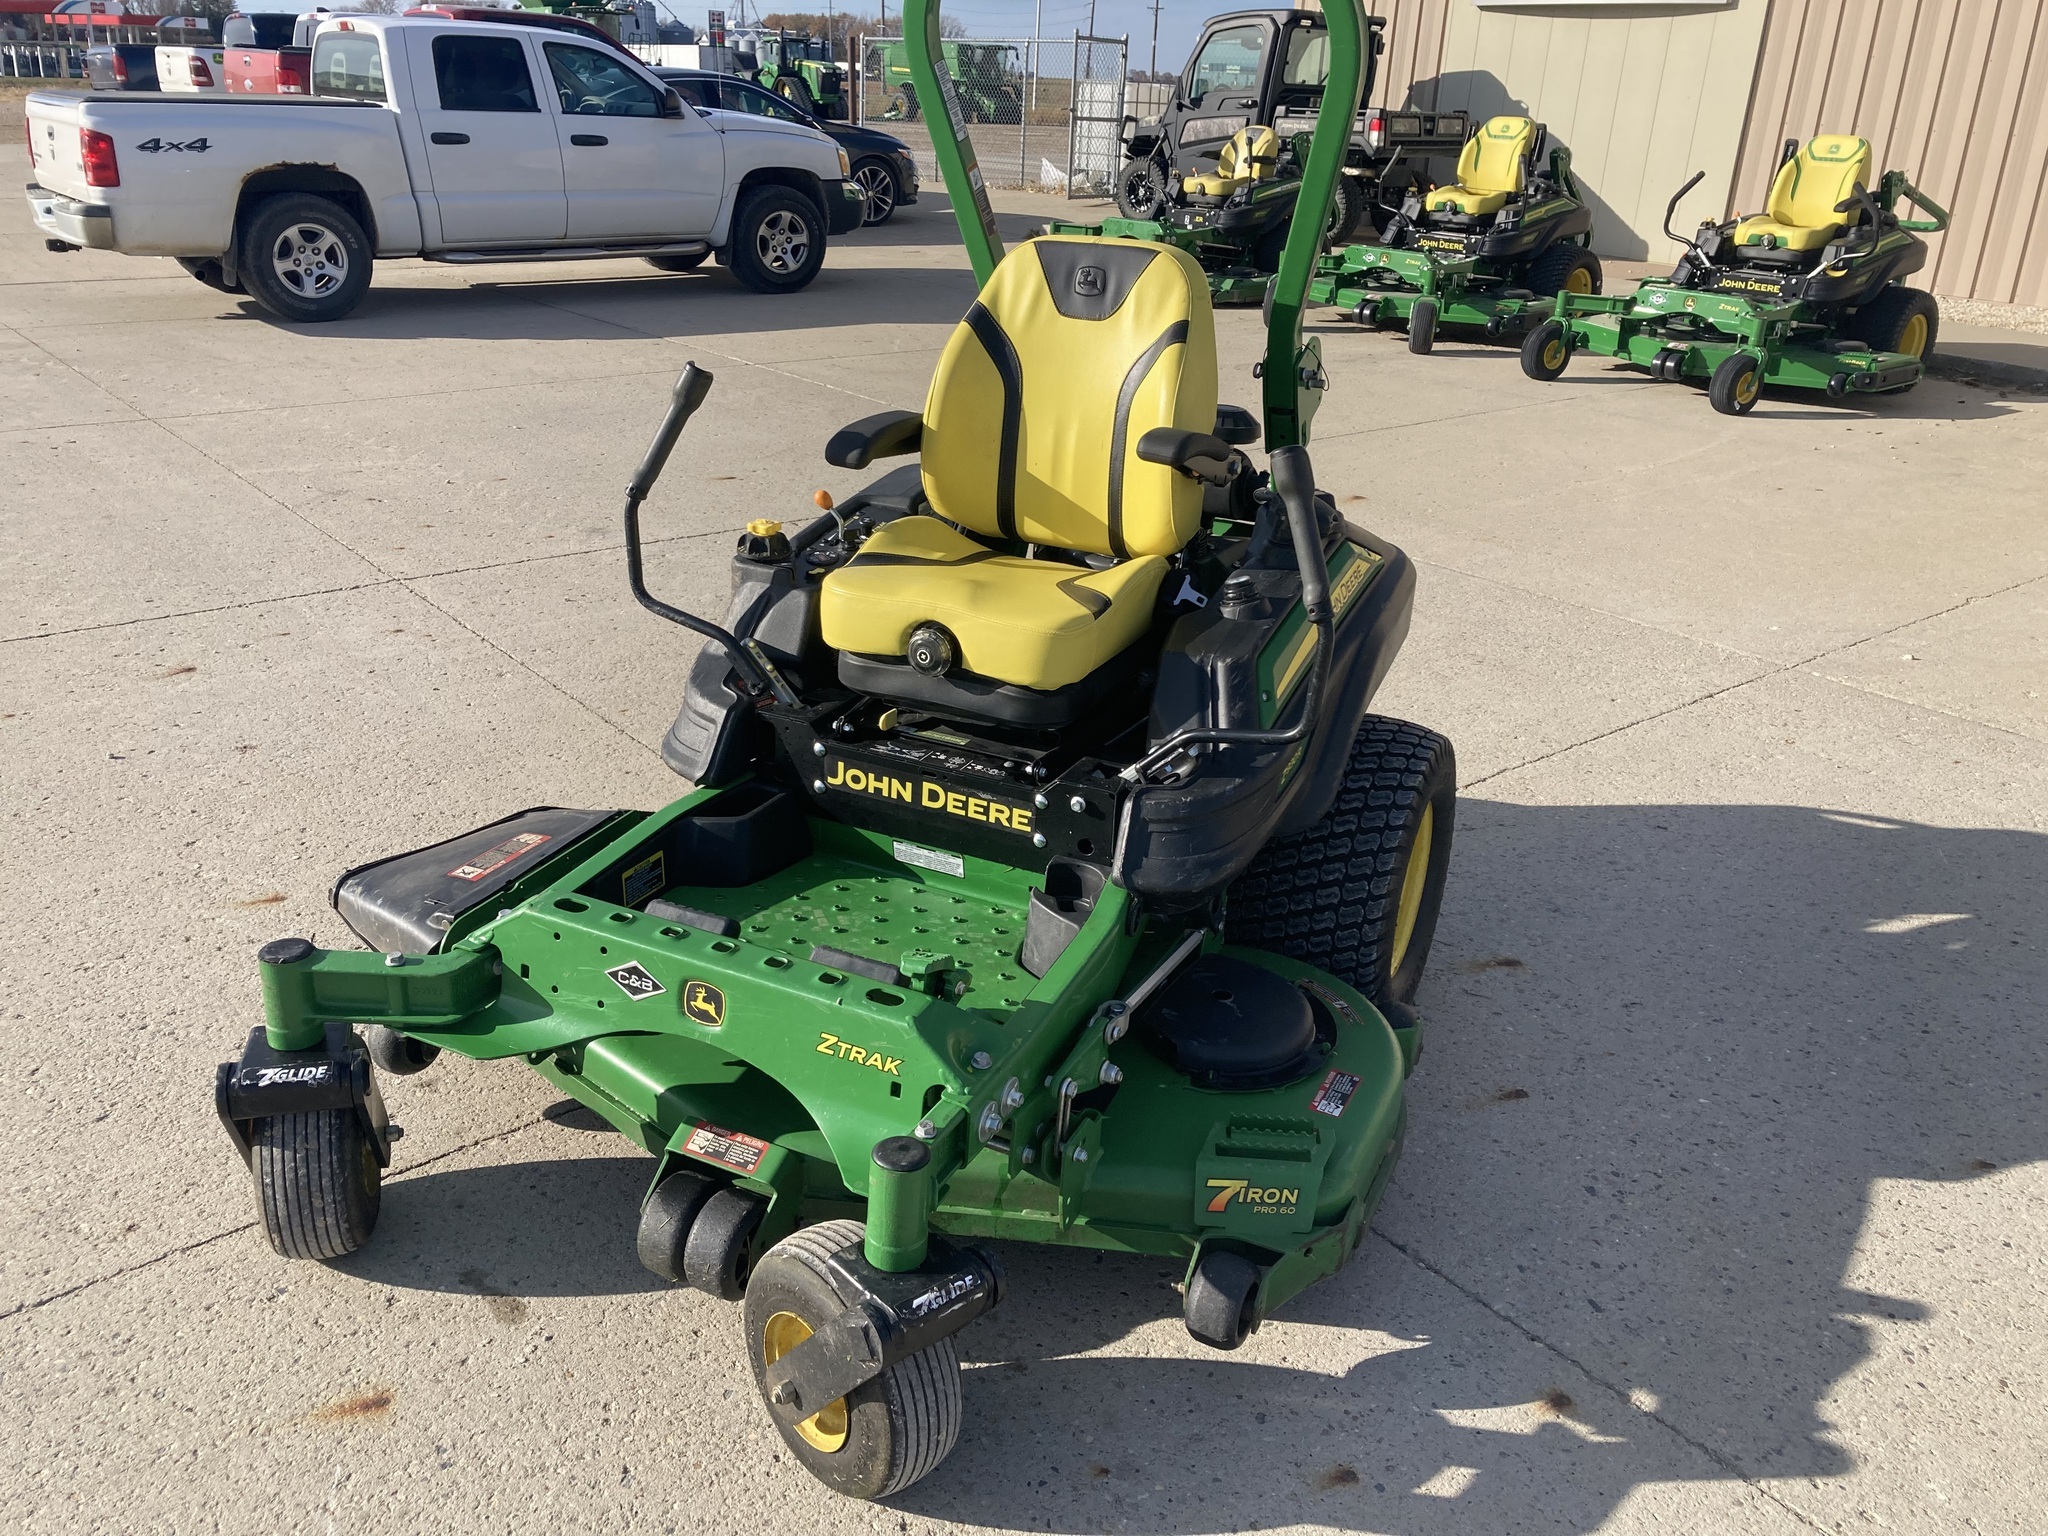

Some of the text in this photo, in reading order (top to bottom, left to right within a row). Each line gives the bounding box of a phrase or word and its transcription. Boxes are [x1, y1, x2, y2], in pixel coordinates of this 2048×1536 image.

[135, 137, 213, 153] 4x4
[1418, 238, 1464, 251] JOHN DEERE
[1718, 277, 1780, 293] JOHN DEERE
[1718, 303, 1740, 312] ZTRAK
[1341, 564, 1363, 600] DEERE
[827, 761, 1033, 832] JOHN DEERE
[617, 970, 654, 992] C&B
[815, 1031, 905, 1077] ZTRAK
[711, 1126, 732, 1137] DANGER
[743, 1135, 764, 1148] PELIGRO
[1253, 1205, 1296, 1215] PRO 60
